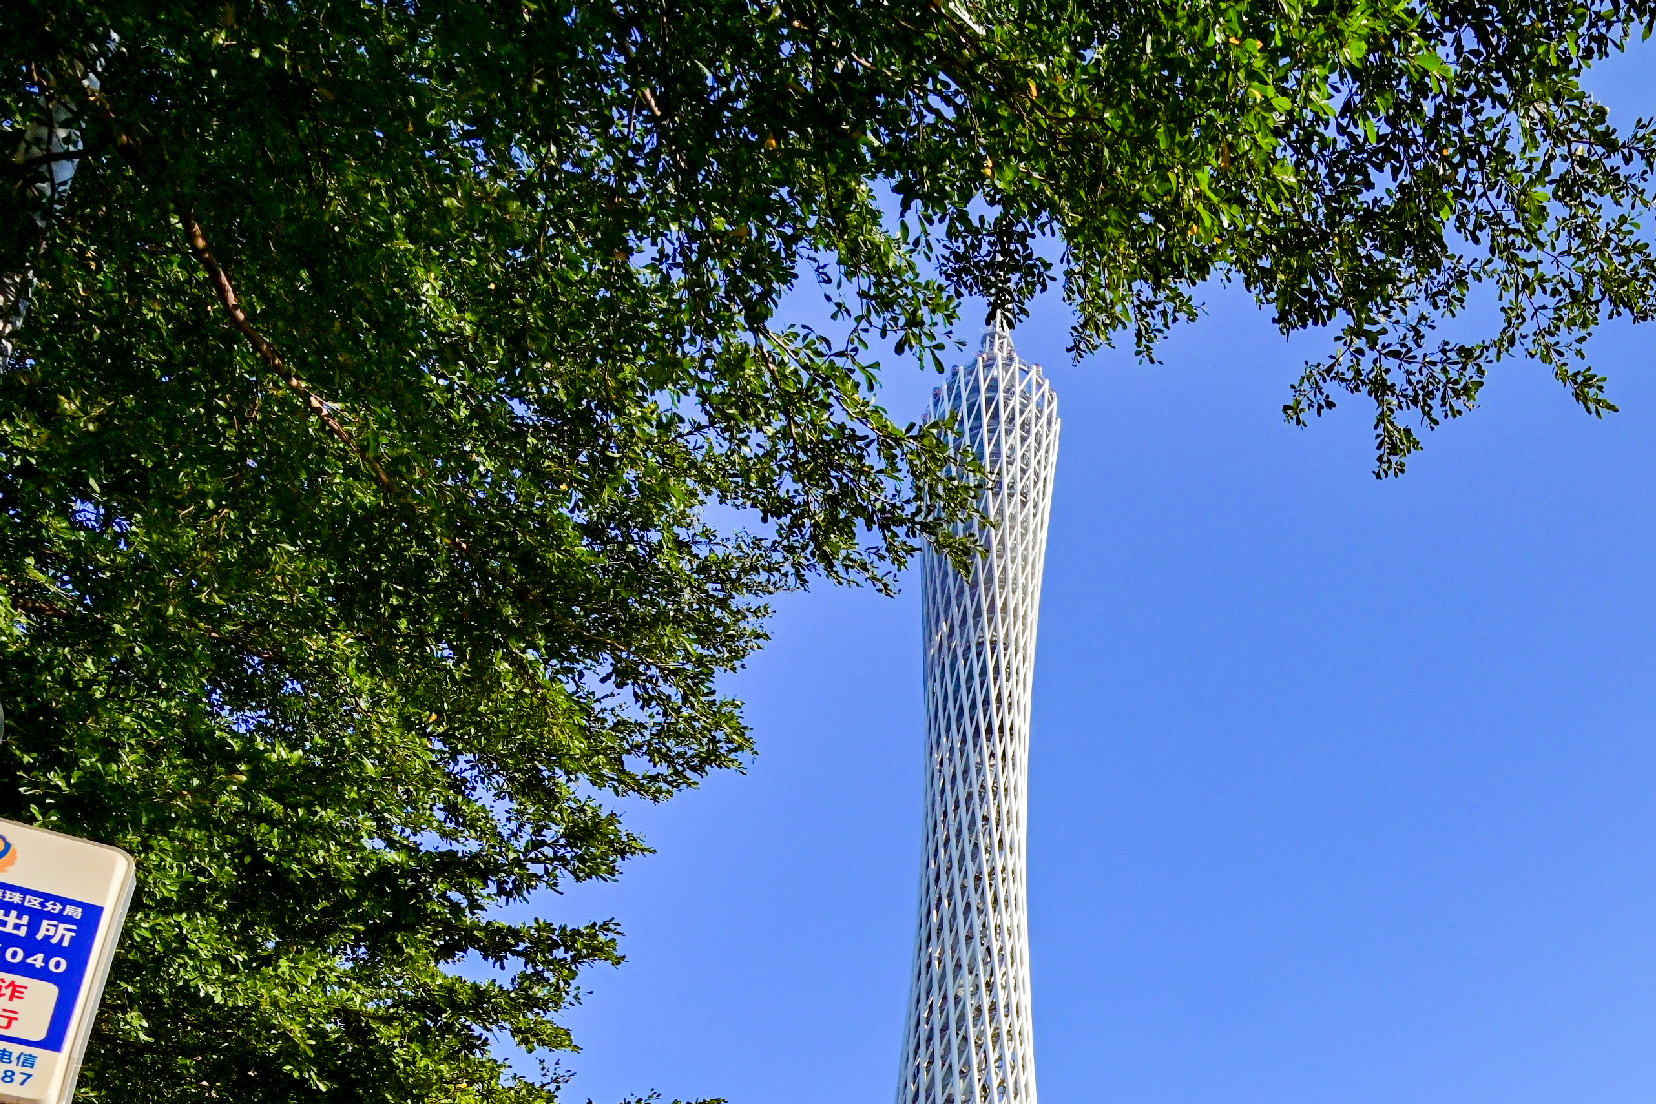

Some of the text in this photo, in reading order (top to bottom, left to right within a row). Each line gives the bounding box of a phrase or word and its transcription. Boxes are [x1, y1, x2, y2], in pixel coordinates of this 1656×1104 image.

[0, 889, 83, 919] 珠区分局
[0, 909, 78, 947] 出所
[0, 943, 67, 973] 040
[1, 1069, 33, 1086] 87
